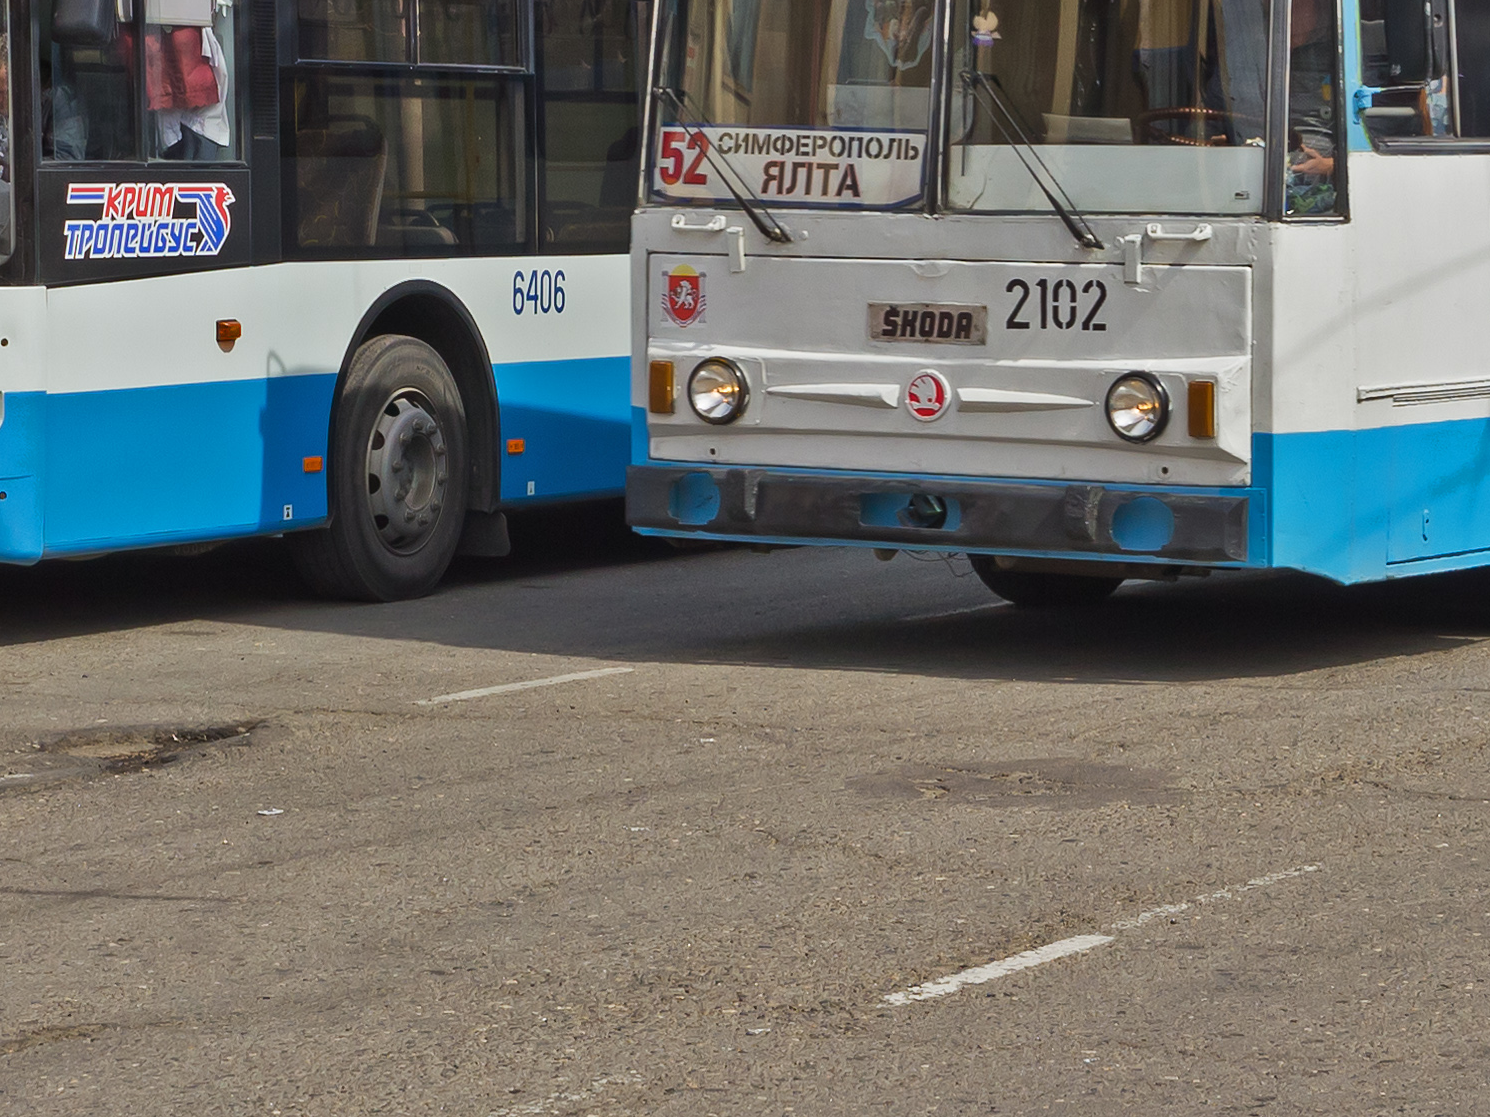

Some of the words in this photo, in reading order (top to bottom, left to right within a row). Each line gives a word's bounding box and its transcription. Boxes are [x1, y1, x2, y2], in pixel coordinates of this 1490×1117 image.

[659, 130, 710, 186] 52
[718, 132, 920, 161] СИМФЕРОПОЛЬ
[760, 160, 861, 198] ЯЛТА
[104, 185, 175, 219] КРИМ
[513, 269, 566, 315] 6406
[1005, 278, 1108, 332] 2102
[881, 304, 973, 340] ŠKODA
